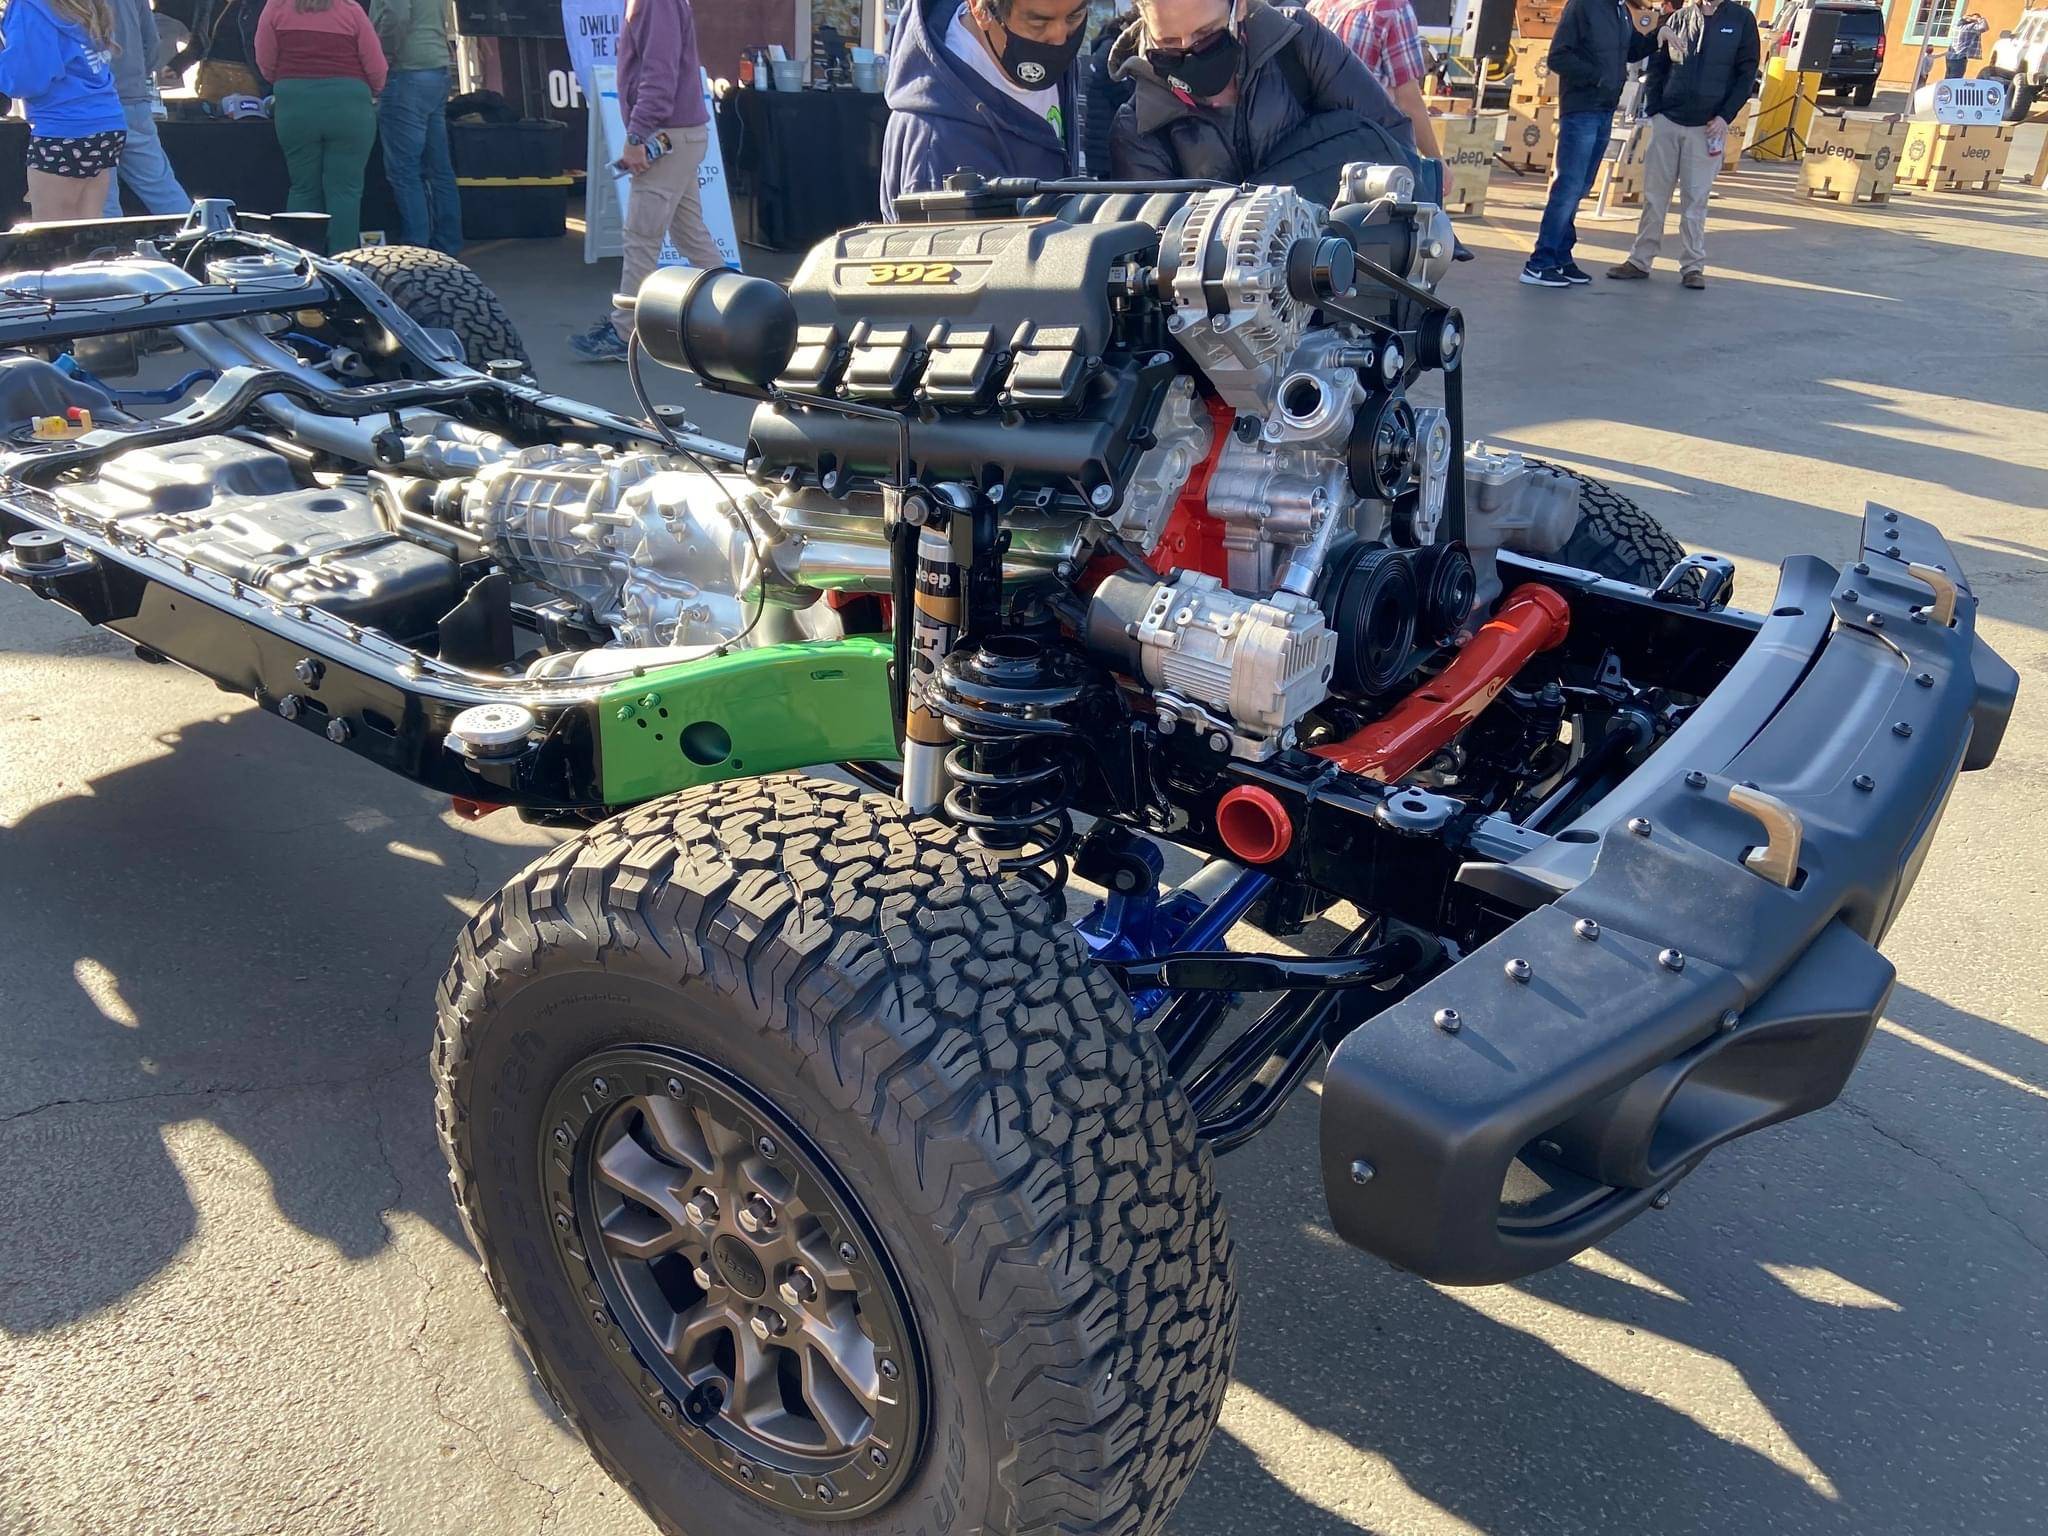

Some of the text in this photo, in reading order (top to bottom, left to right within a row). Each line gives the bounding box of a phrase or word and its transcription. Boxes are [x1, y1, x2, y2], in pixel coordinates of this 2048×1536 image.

[1452, 148, 1484, 167] Jeep
[1816, 140, 1855, 162] Jeep
[1961, 145, 1990, 160] Jeep
[659, 250, 681, 260] JEE
[866, 262, 955, 283] 392
[916, 568, 951, 589] eep
